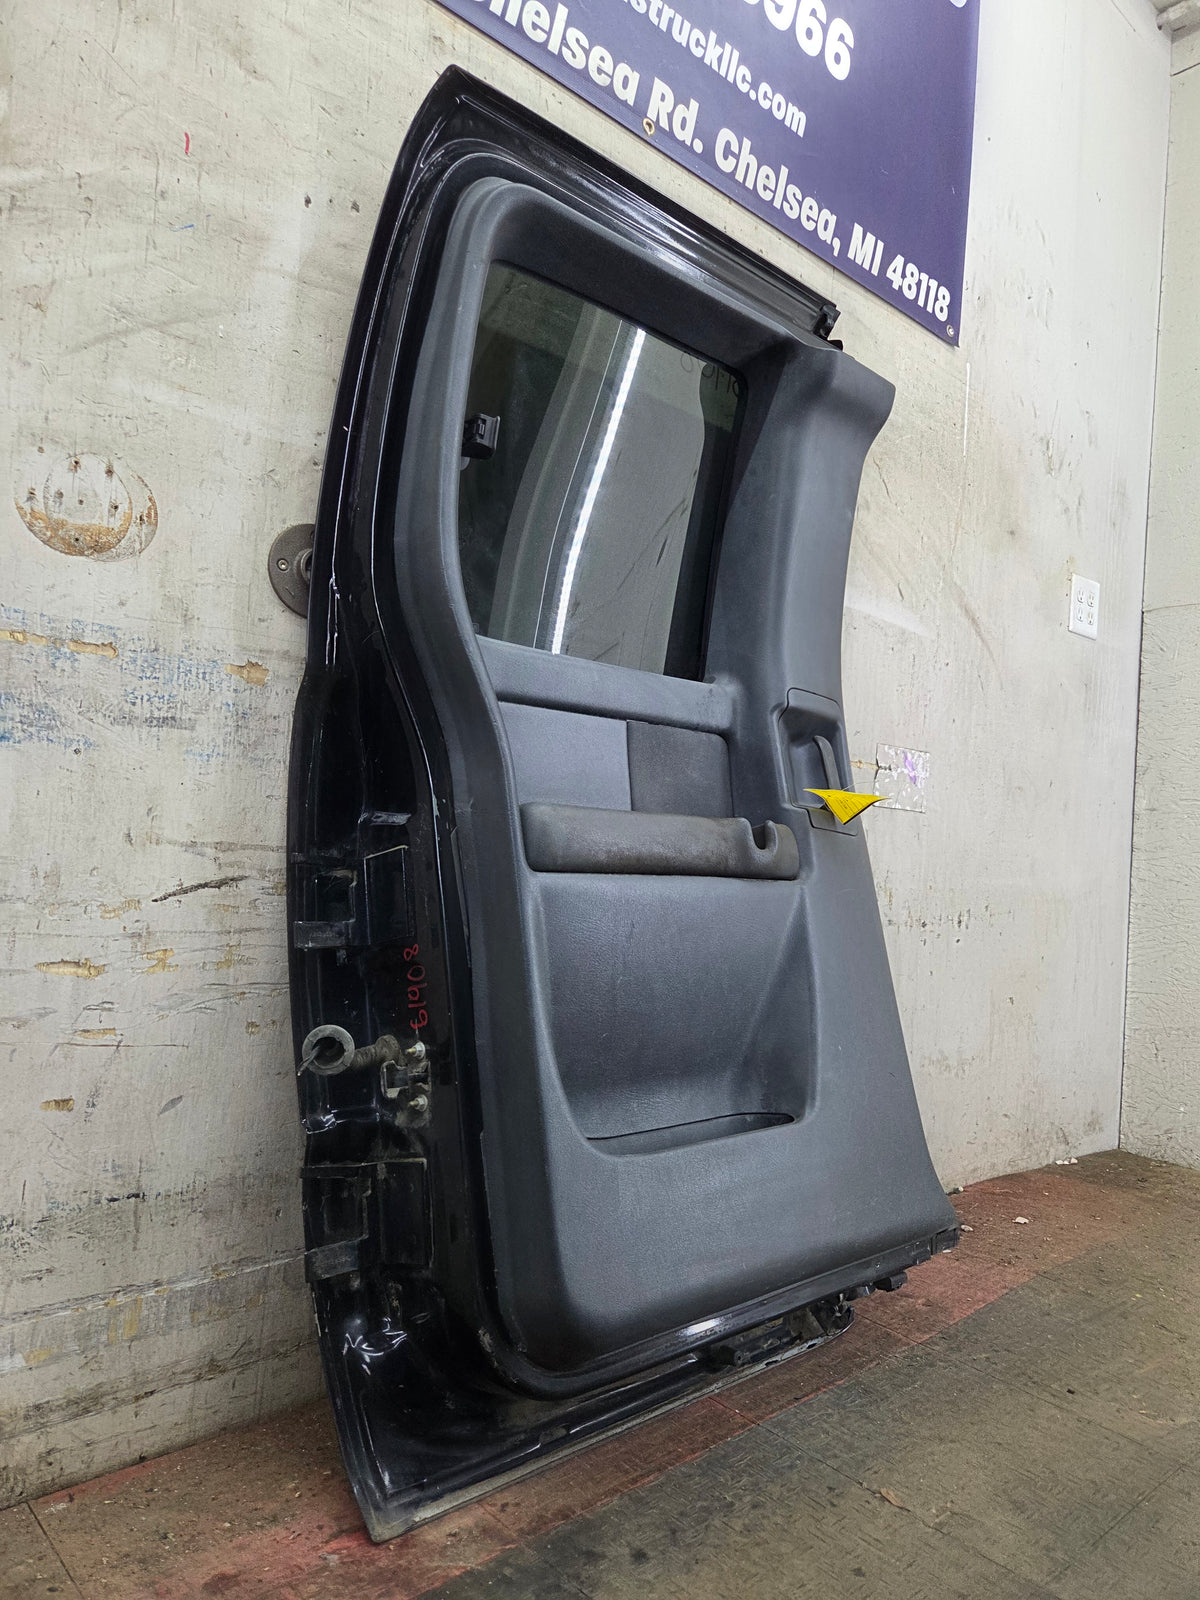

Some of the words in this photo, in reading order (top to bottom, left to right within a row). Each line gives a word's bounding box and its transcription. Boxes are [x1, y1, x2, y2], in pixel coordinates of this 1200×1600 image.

[743, 0, 855, 81] 966
[646, 76, 703, 154] Rd.
[714, 127, 840, 257] Chelsea,
[847, 222, 885, 277] MI
[885, 254, 951, 322] 48118
[403, 943, 429, 1030] 61908
